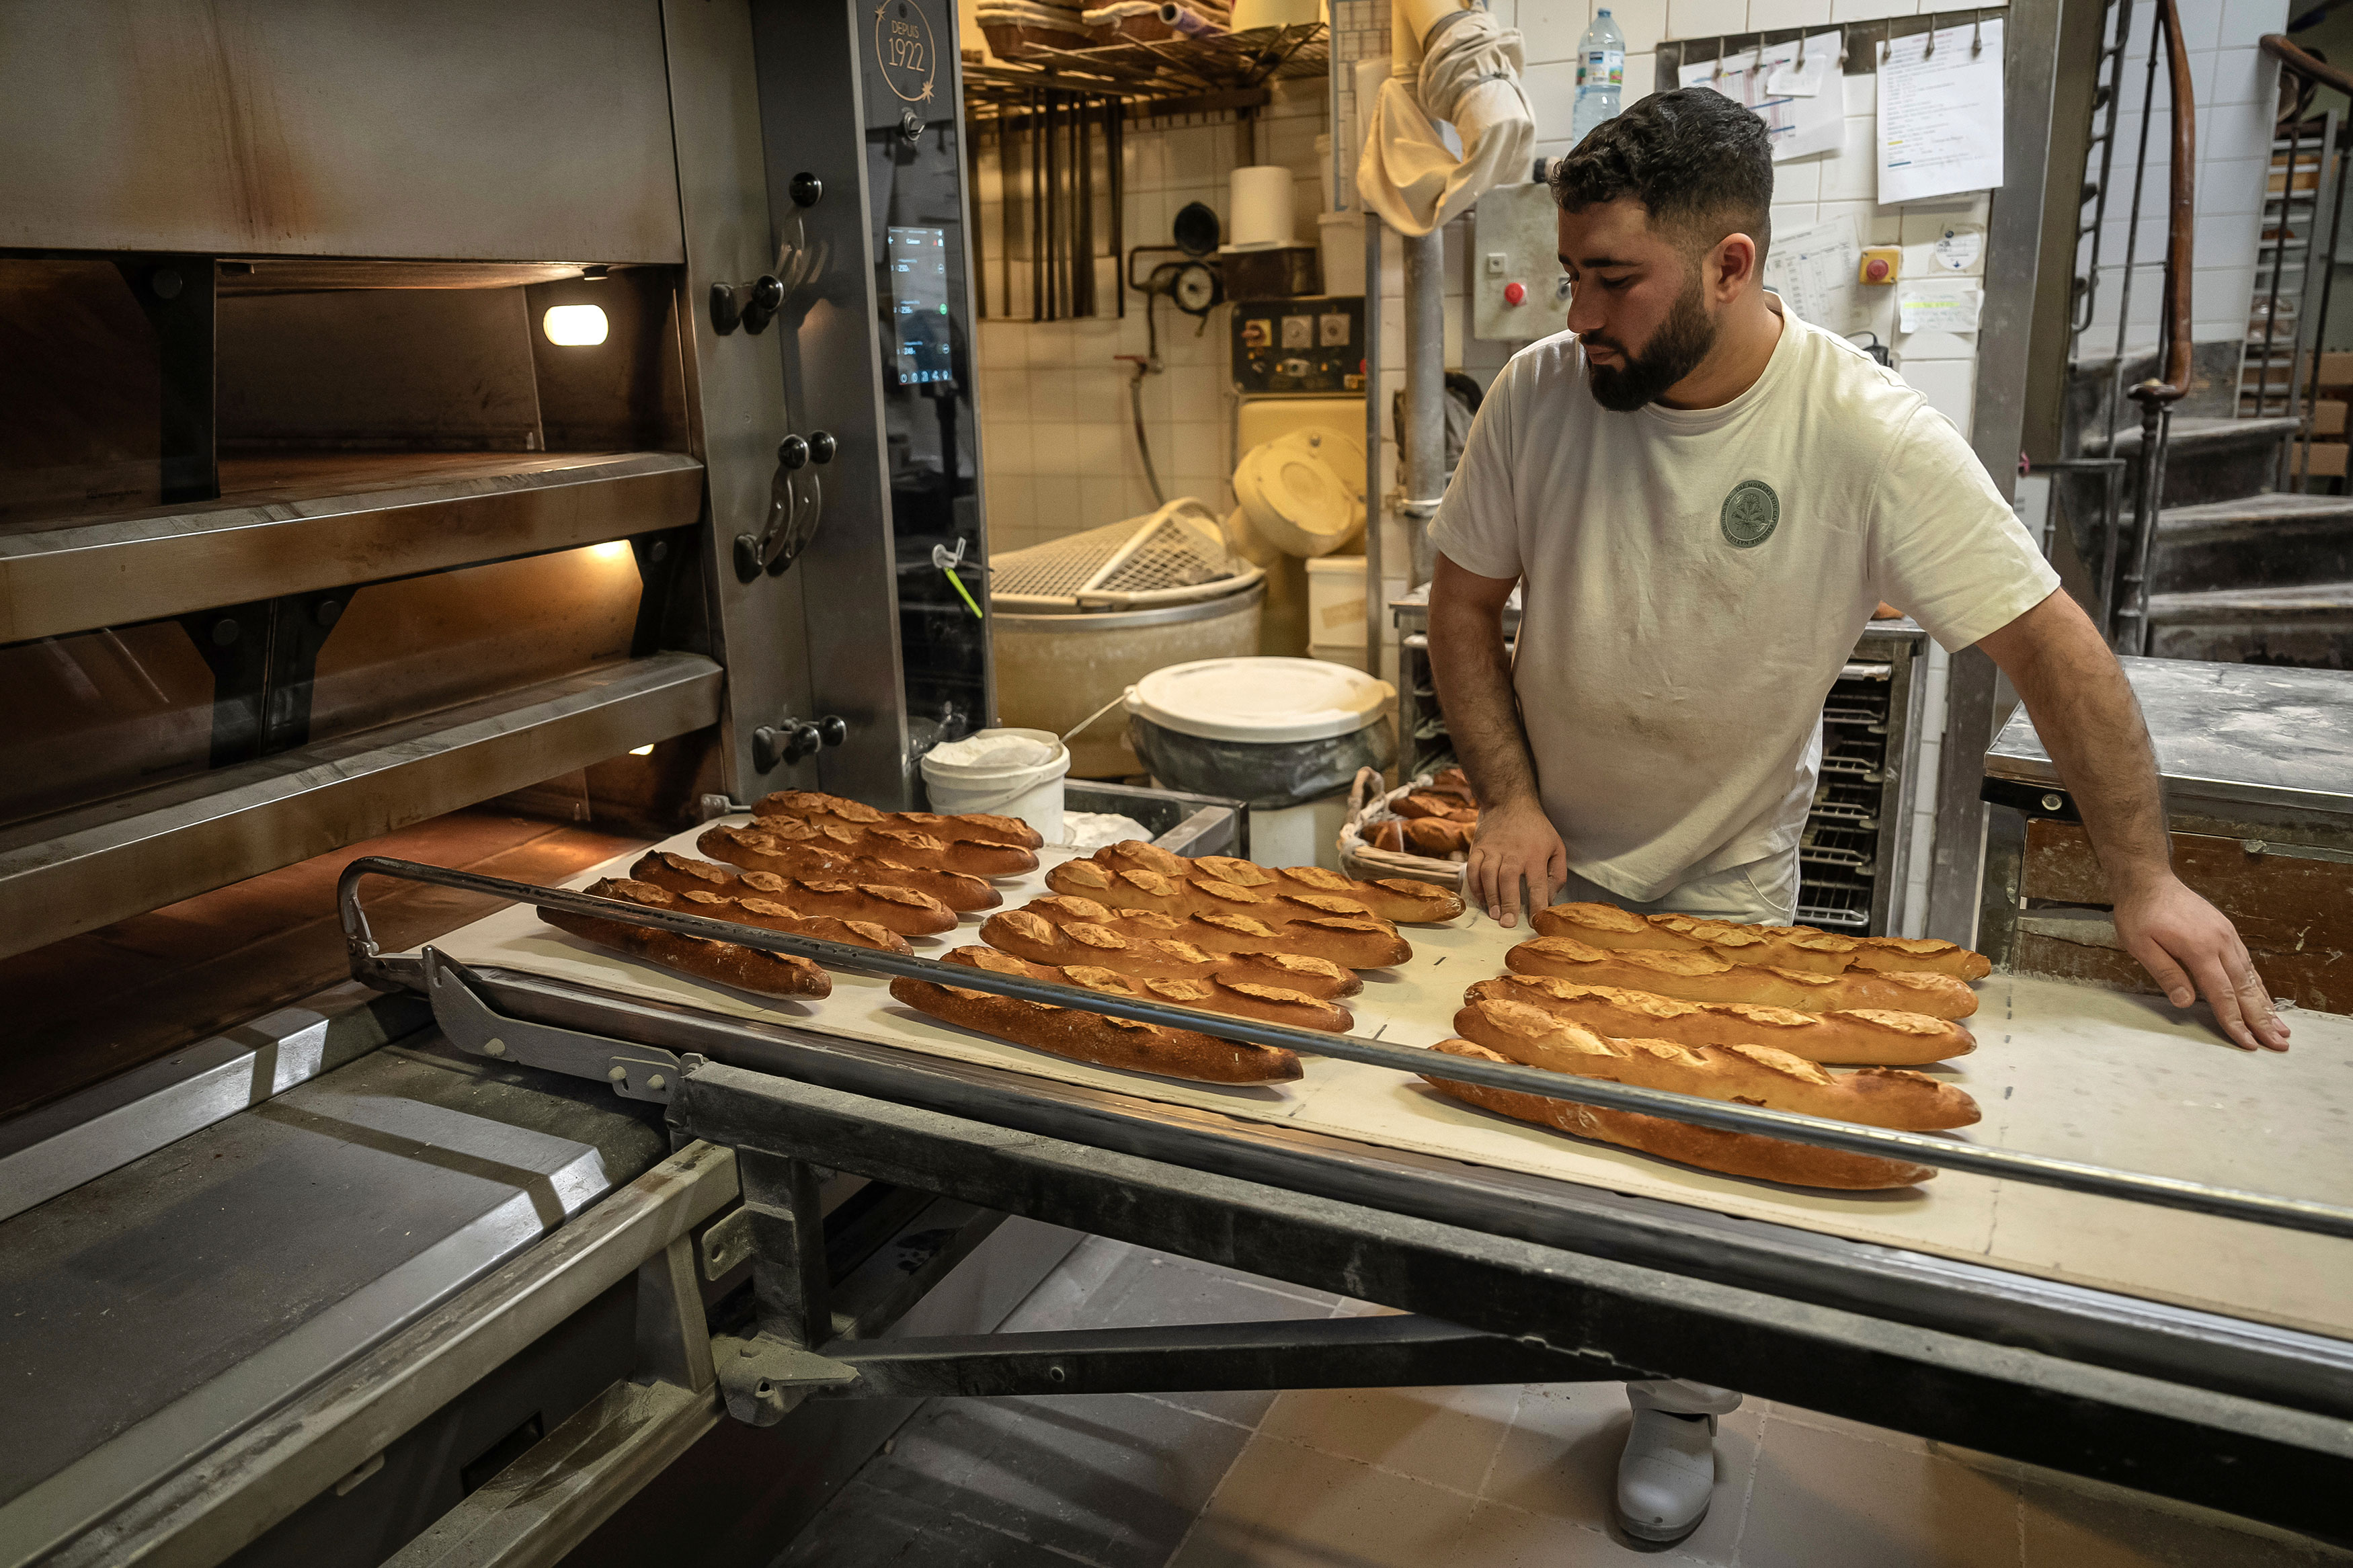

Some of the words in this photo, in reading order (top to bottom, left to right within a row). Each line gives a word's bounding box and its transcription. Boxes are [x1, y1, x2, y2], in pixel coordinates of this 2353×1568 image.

[891, 20, 920, 39] DEPUIS
[888, 38, 925, 72] 1922
[1735, 483, 1747, 492] THE
[1748, 483, 1773, 496] MOMENT
[1765, 524, 1774, 536] FEEL
[1751, 536, 1763, 544] THE
